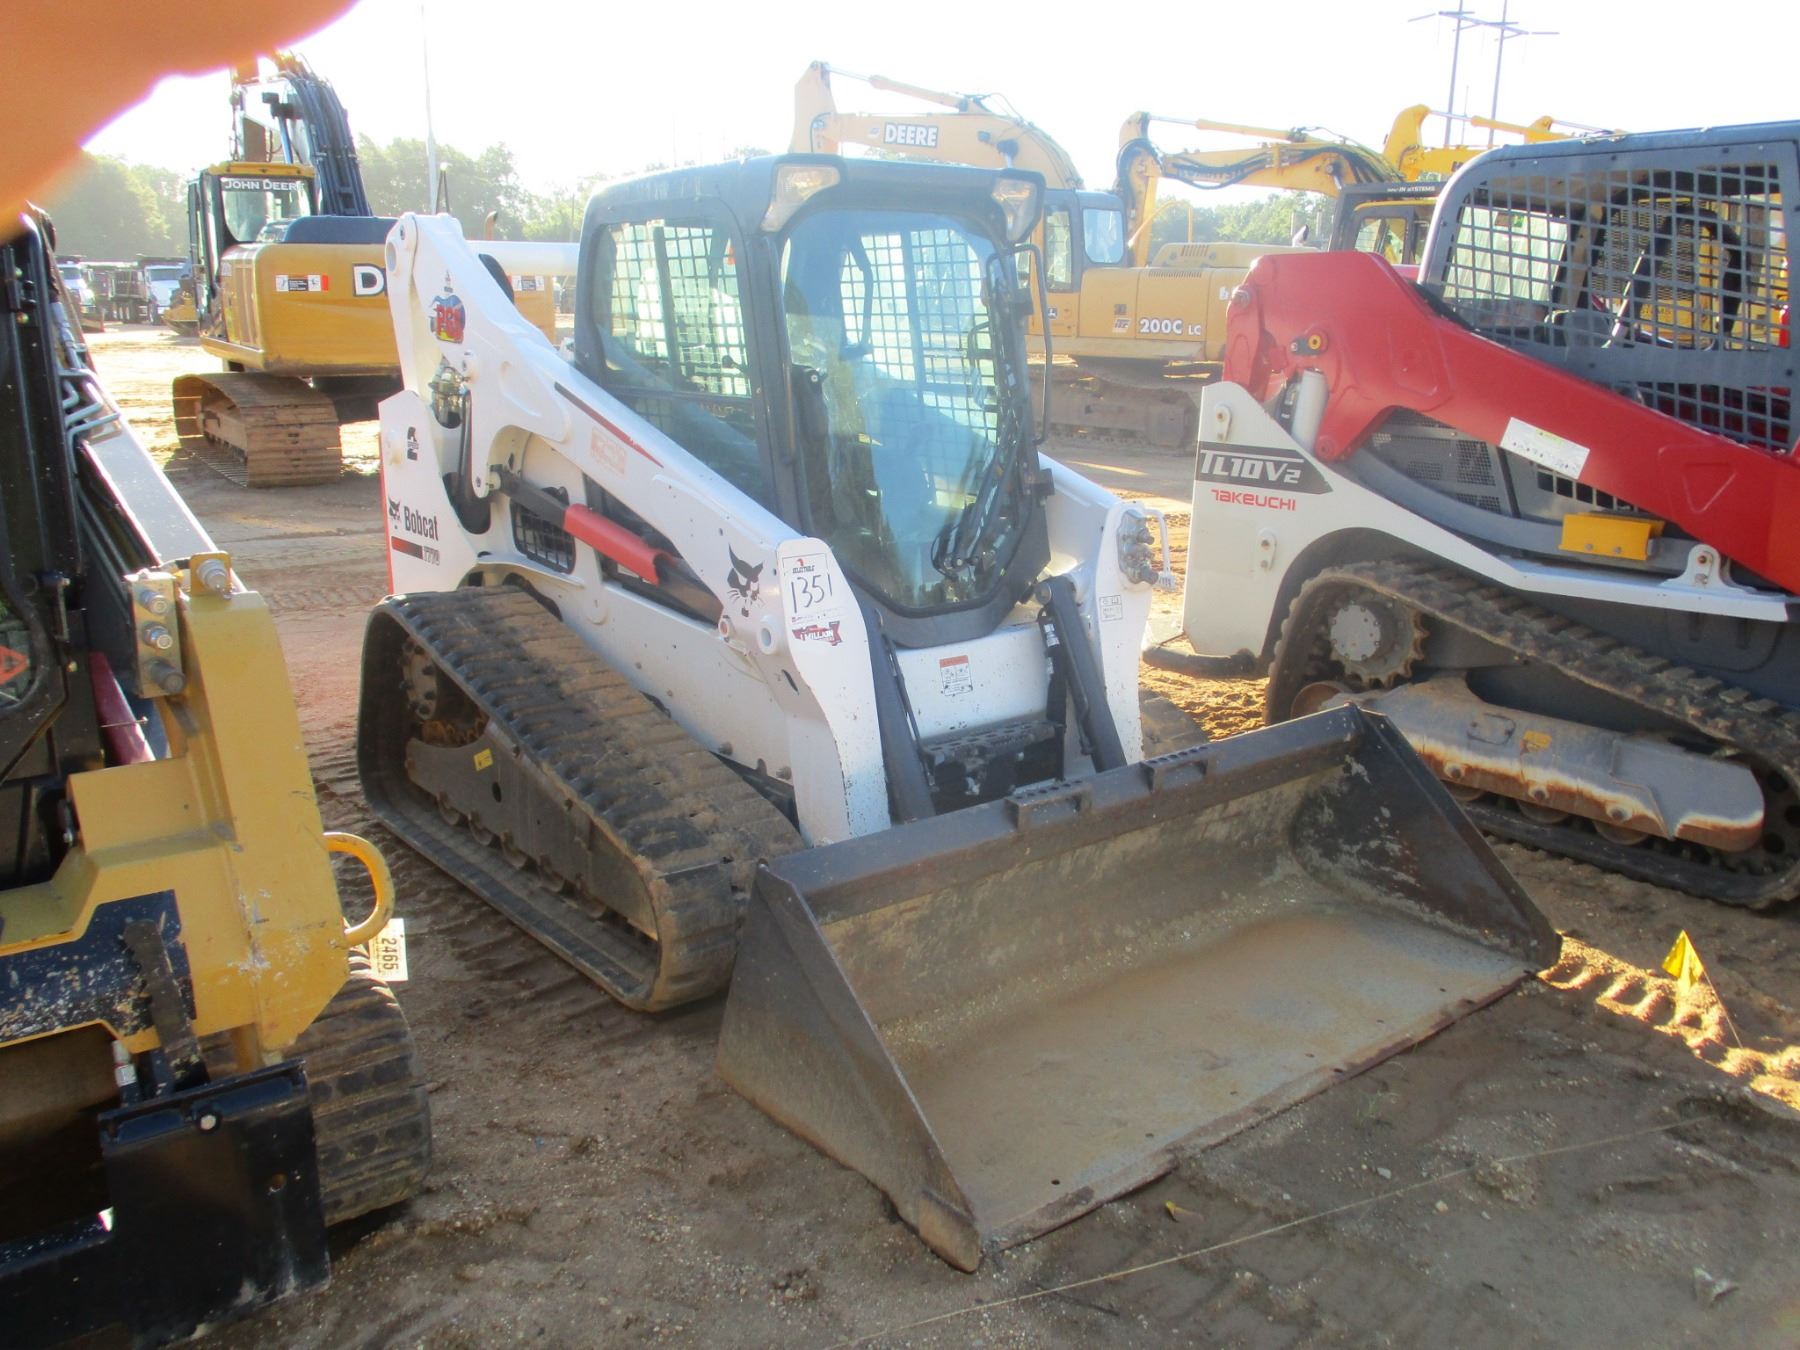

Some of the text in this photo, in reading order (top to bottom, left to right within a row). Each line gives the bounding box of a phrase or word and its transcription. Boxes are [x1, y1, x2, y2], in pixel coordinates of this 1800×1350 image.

[884, 123, 938, 148] DEERE
[225, 180, 305, 190] JOHN DEERE
[1140, 319, 1183, 335] 200C
[1188, 325, 1202, 336] LC
[1200, 449, 1305, 484] TL10V2
[1211, 489, 1297, 511] TAKEUCHI
[404, 506, 439, 541] Bobcat
[791, 573, 833, 614] 1351
[382, 938, 399, 970] 2465
